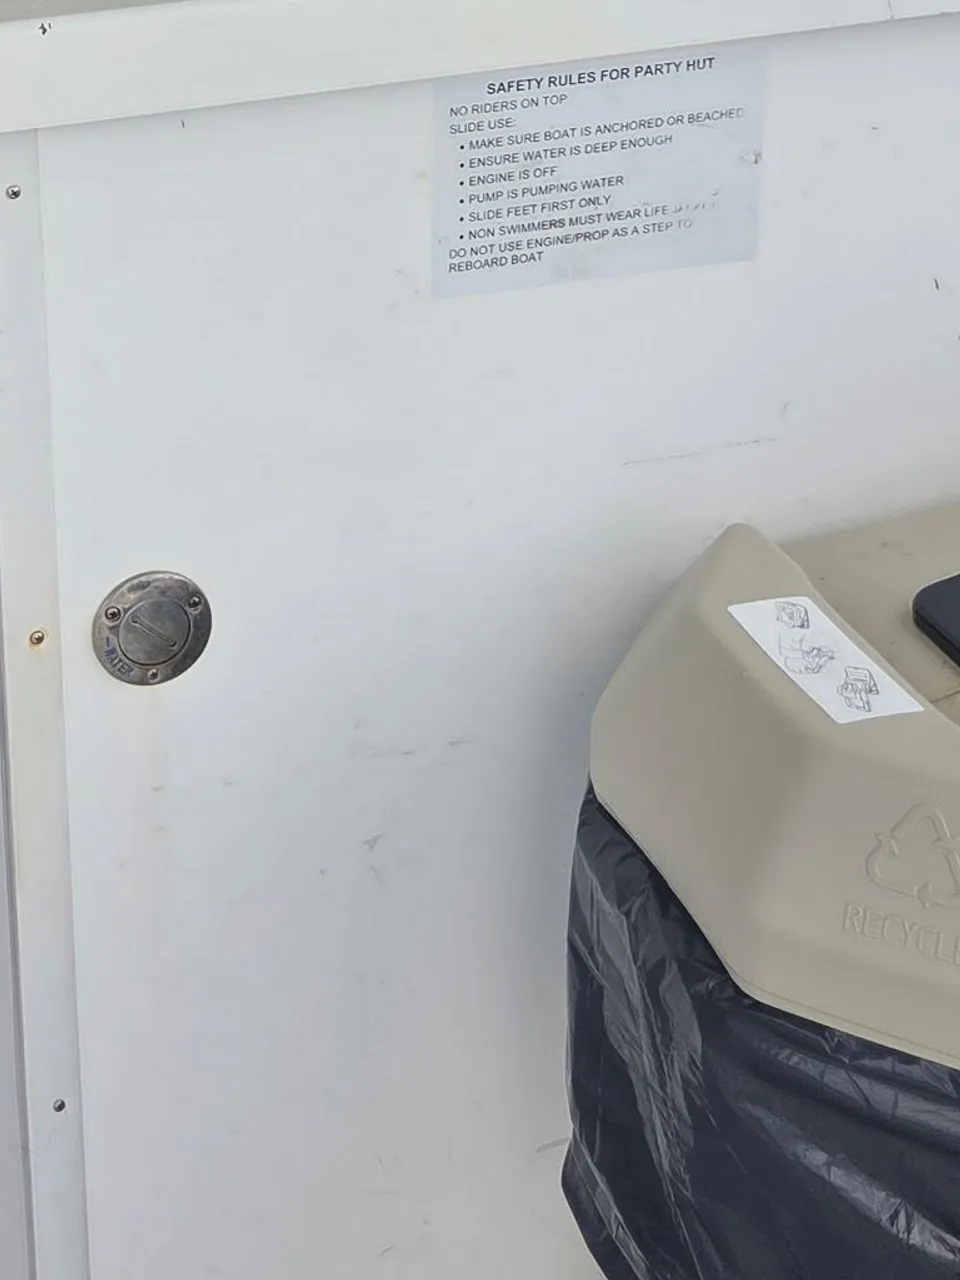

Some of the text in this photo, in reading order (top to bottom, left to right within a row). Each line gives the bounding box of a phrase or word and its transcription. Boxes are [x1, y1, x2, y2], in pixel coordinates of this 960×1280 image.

[486, 57, 715, 96] SAFETY RULES FOR PARTY HUT
[449, 93, 568, 118] NO RIDERS ON TOP
[449, 120, 485, 135] SLIDE
[469, 107, 745, 151] MAKE SURE BOAT IS ANCHORED OR BEACHED
[469, 134, 673, 169] ENSURE WATER IS DEEP ENOUGH
[468, 165, 558, 187] ENGINE IS OFF
[468, 175, 624, 205] PUMP IS PUMPING WATER
[468, 195, 612, 223] SLIDE FEET FIRST ONLY
[468, 227, 496, 241] NON
[498, 218, 566, 237] SWIMMERS
[569, 213, 603, 227] MUST
[605, 208, 641, 223] WEAR
[643, 204, 669, 217] LIFE
[449, 247, 467, 260] DO
[470, 243, 495, 257] NOT
[498, 240, 524, 253] USE
[526, 229, 610, 249] ENGINE/PROP
[612, 226, 629, 239] AS
[631, 224, 640, 236] A
[642, 220, 674, 235] STEP
[449, 251, 544, 273] REBOARD BOAT
